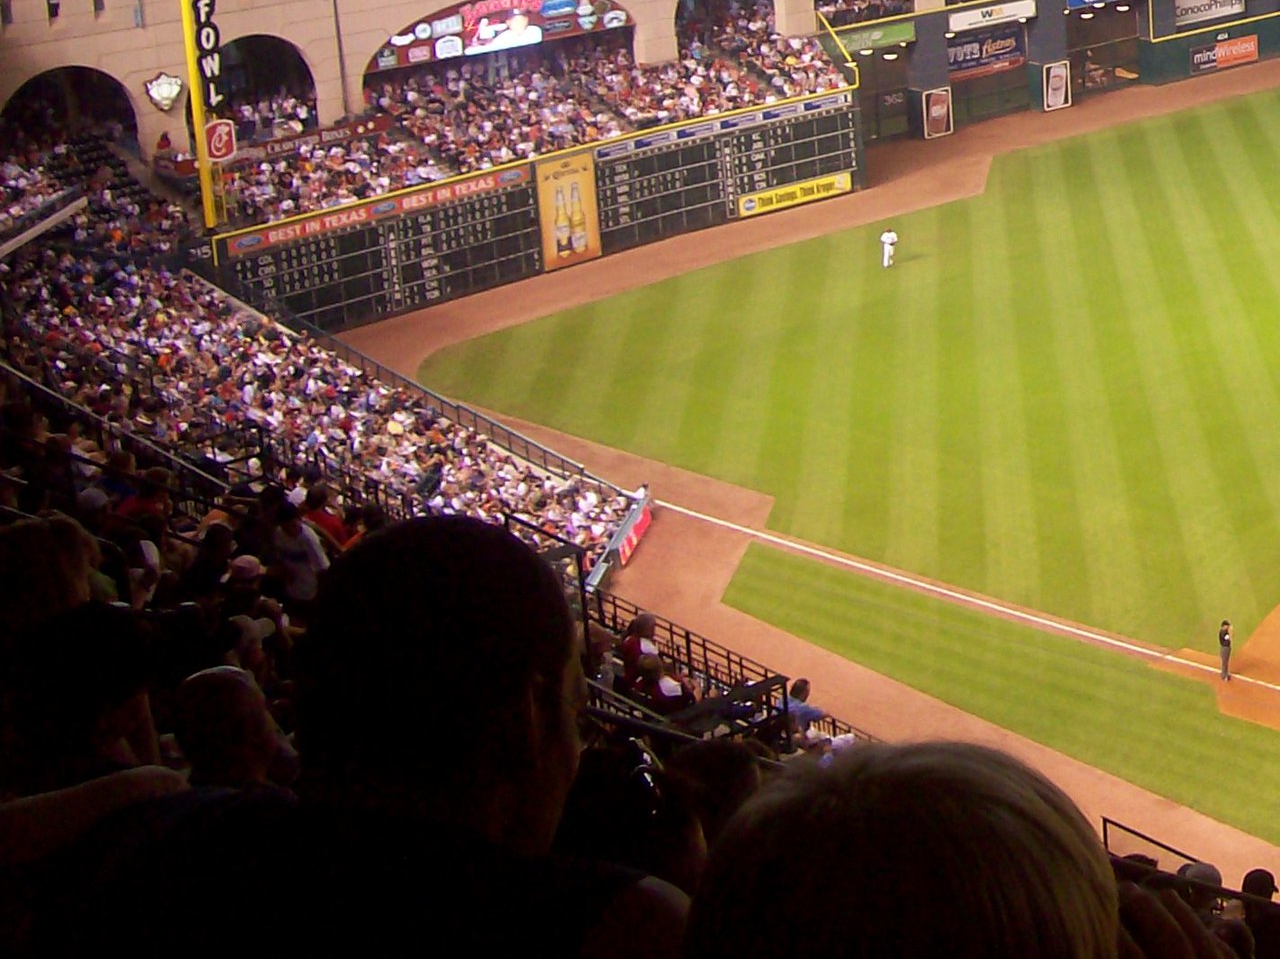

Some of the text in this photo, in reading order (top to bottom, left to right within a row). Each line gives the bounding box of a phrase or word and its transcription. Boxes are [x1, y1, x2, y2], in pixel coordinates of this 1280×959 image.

[1193, 41, 1256, 64] mindWireless
[402, 193, 433, 210] BEST
[436, 188, 450, 200] IN
[455, 177, 495, 196] TEXAS
[268, 223, 301, 243] BEST
[305, 219, 320, 233] IN
[325, 208, 367, 230] TEXAS
